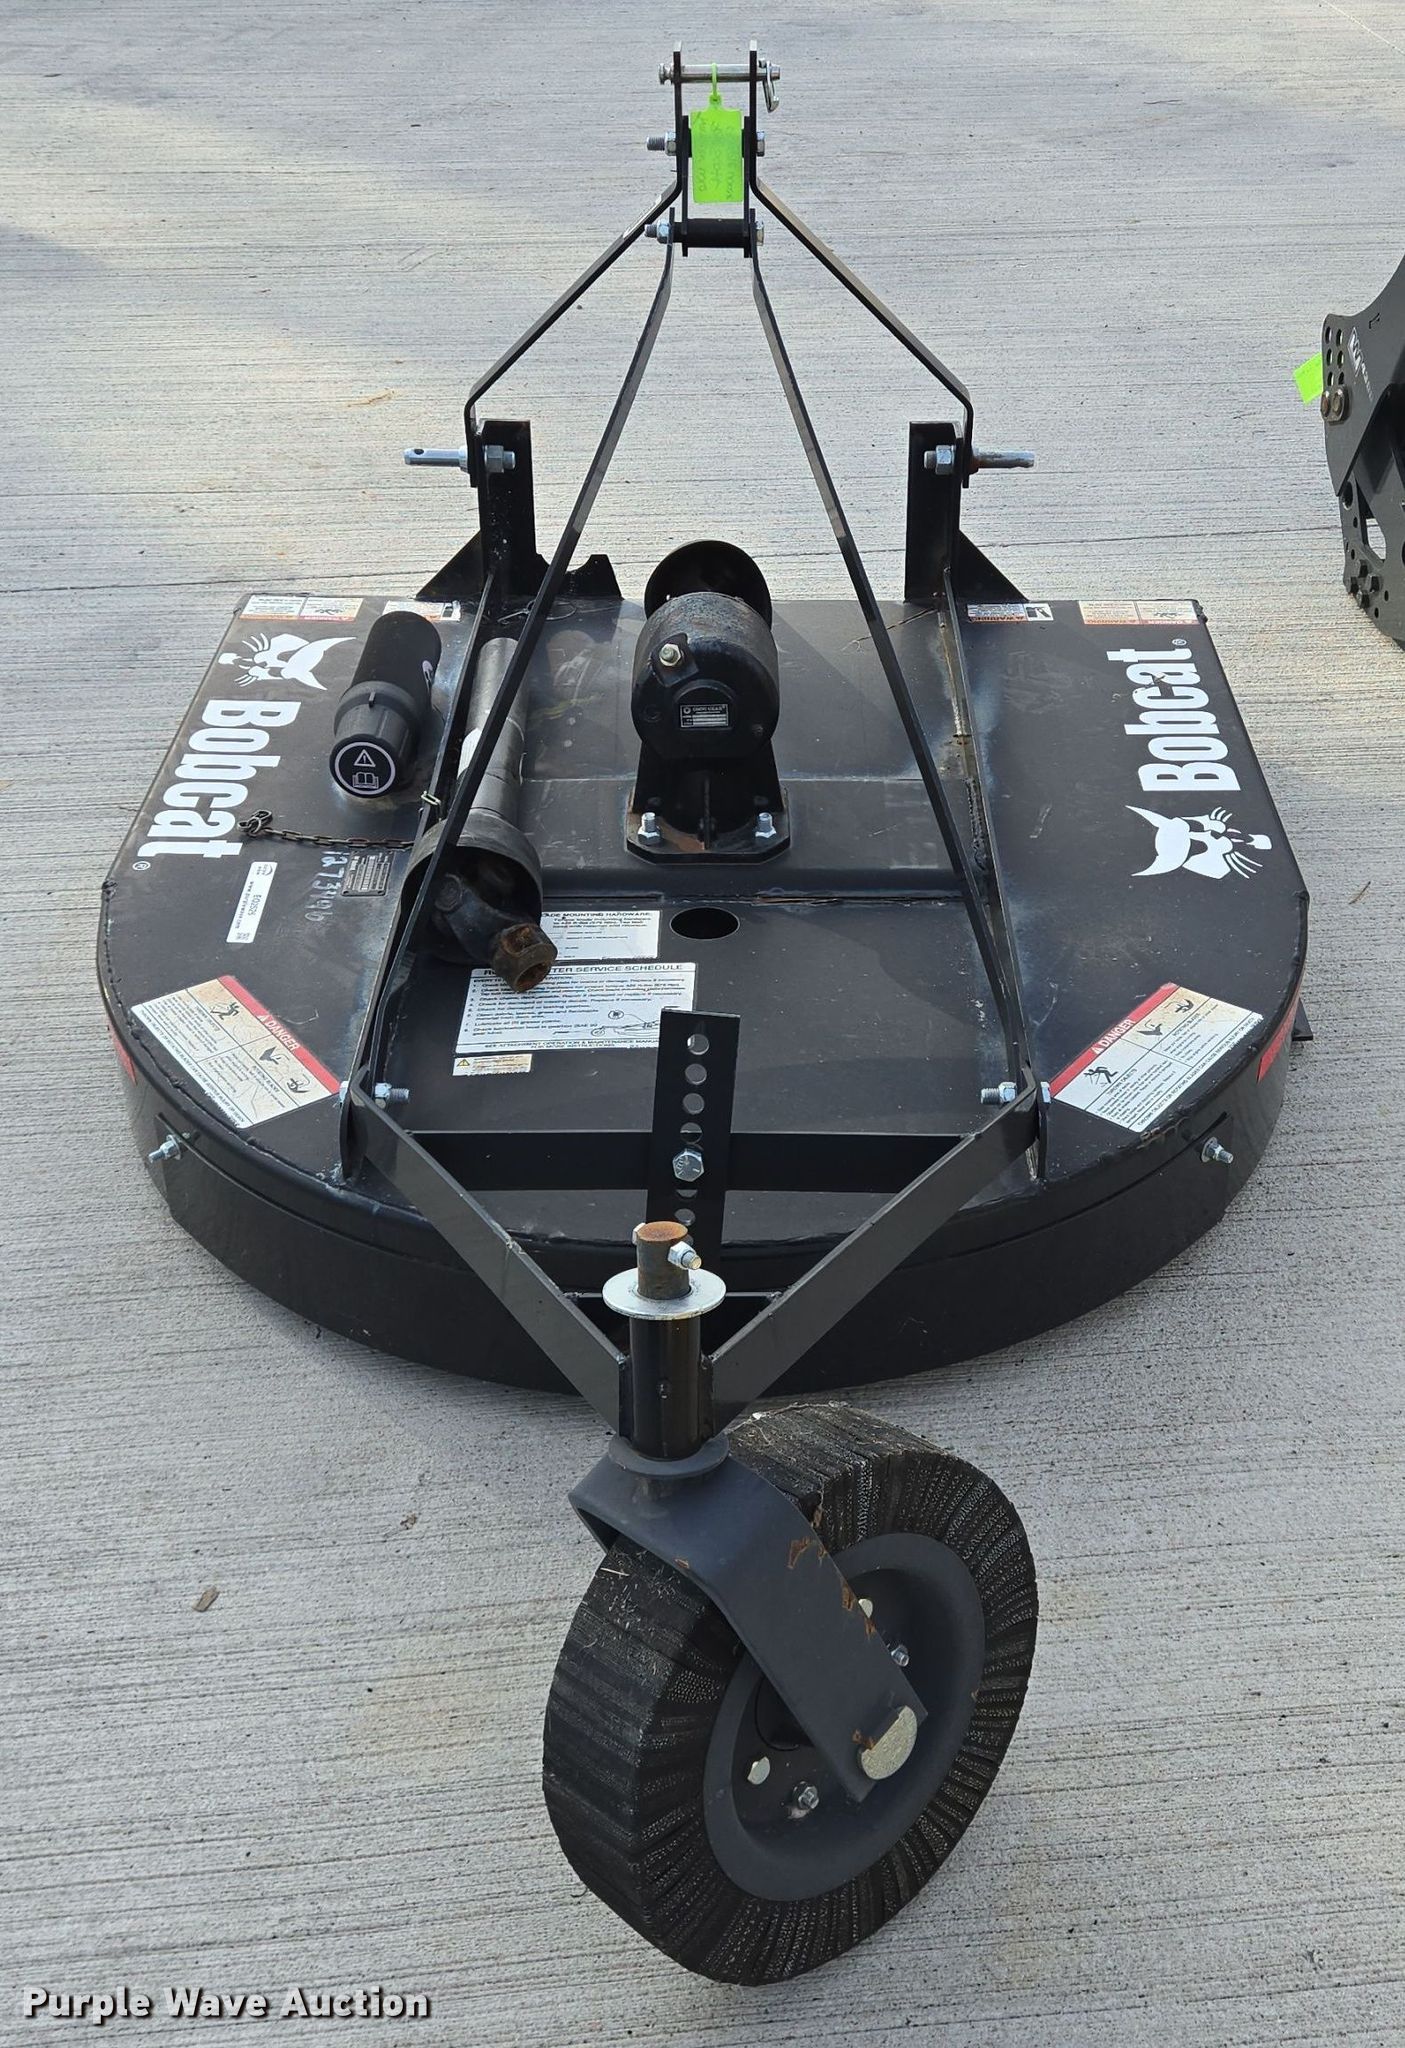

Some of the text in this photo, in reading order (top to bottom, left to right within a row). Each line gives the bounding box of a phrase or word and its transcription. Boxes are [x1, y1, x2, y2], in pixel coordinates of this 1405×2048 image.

[1107, 649, 1241, 791] Bobcat
[138, 700, 301, 858] Bobcat
[624, 963, 682, 971] SCHEDULE
[266, 1018, 301, 1052] DANGER
[1099, 1019, 1135, 1047] DANGER
